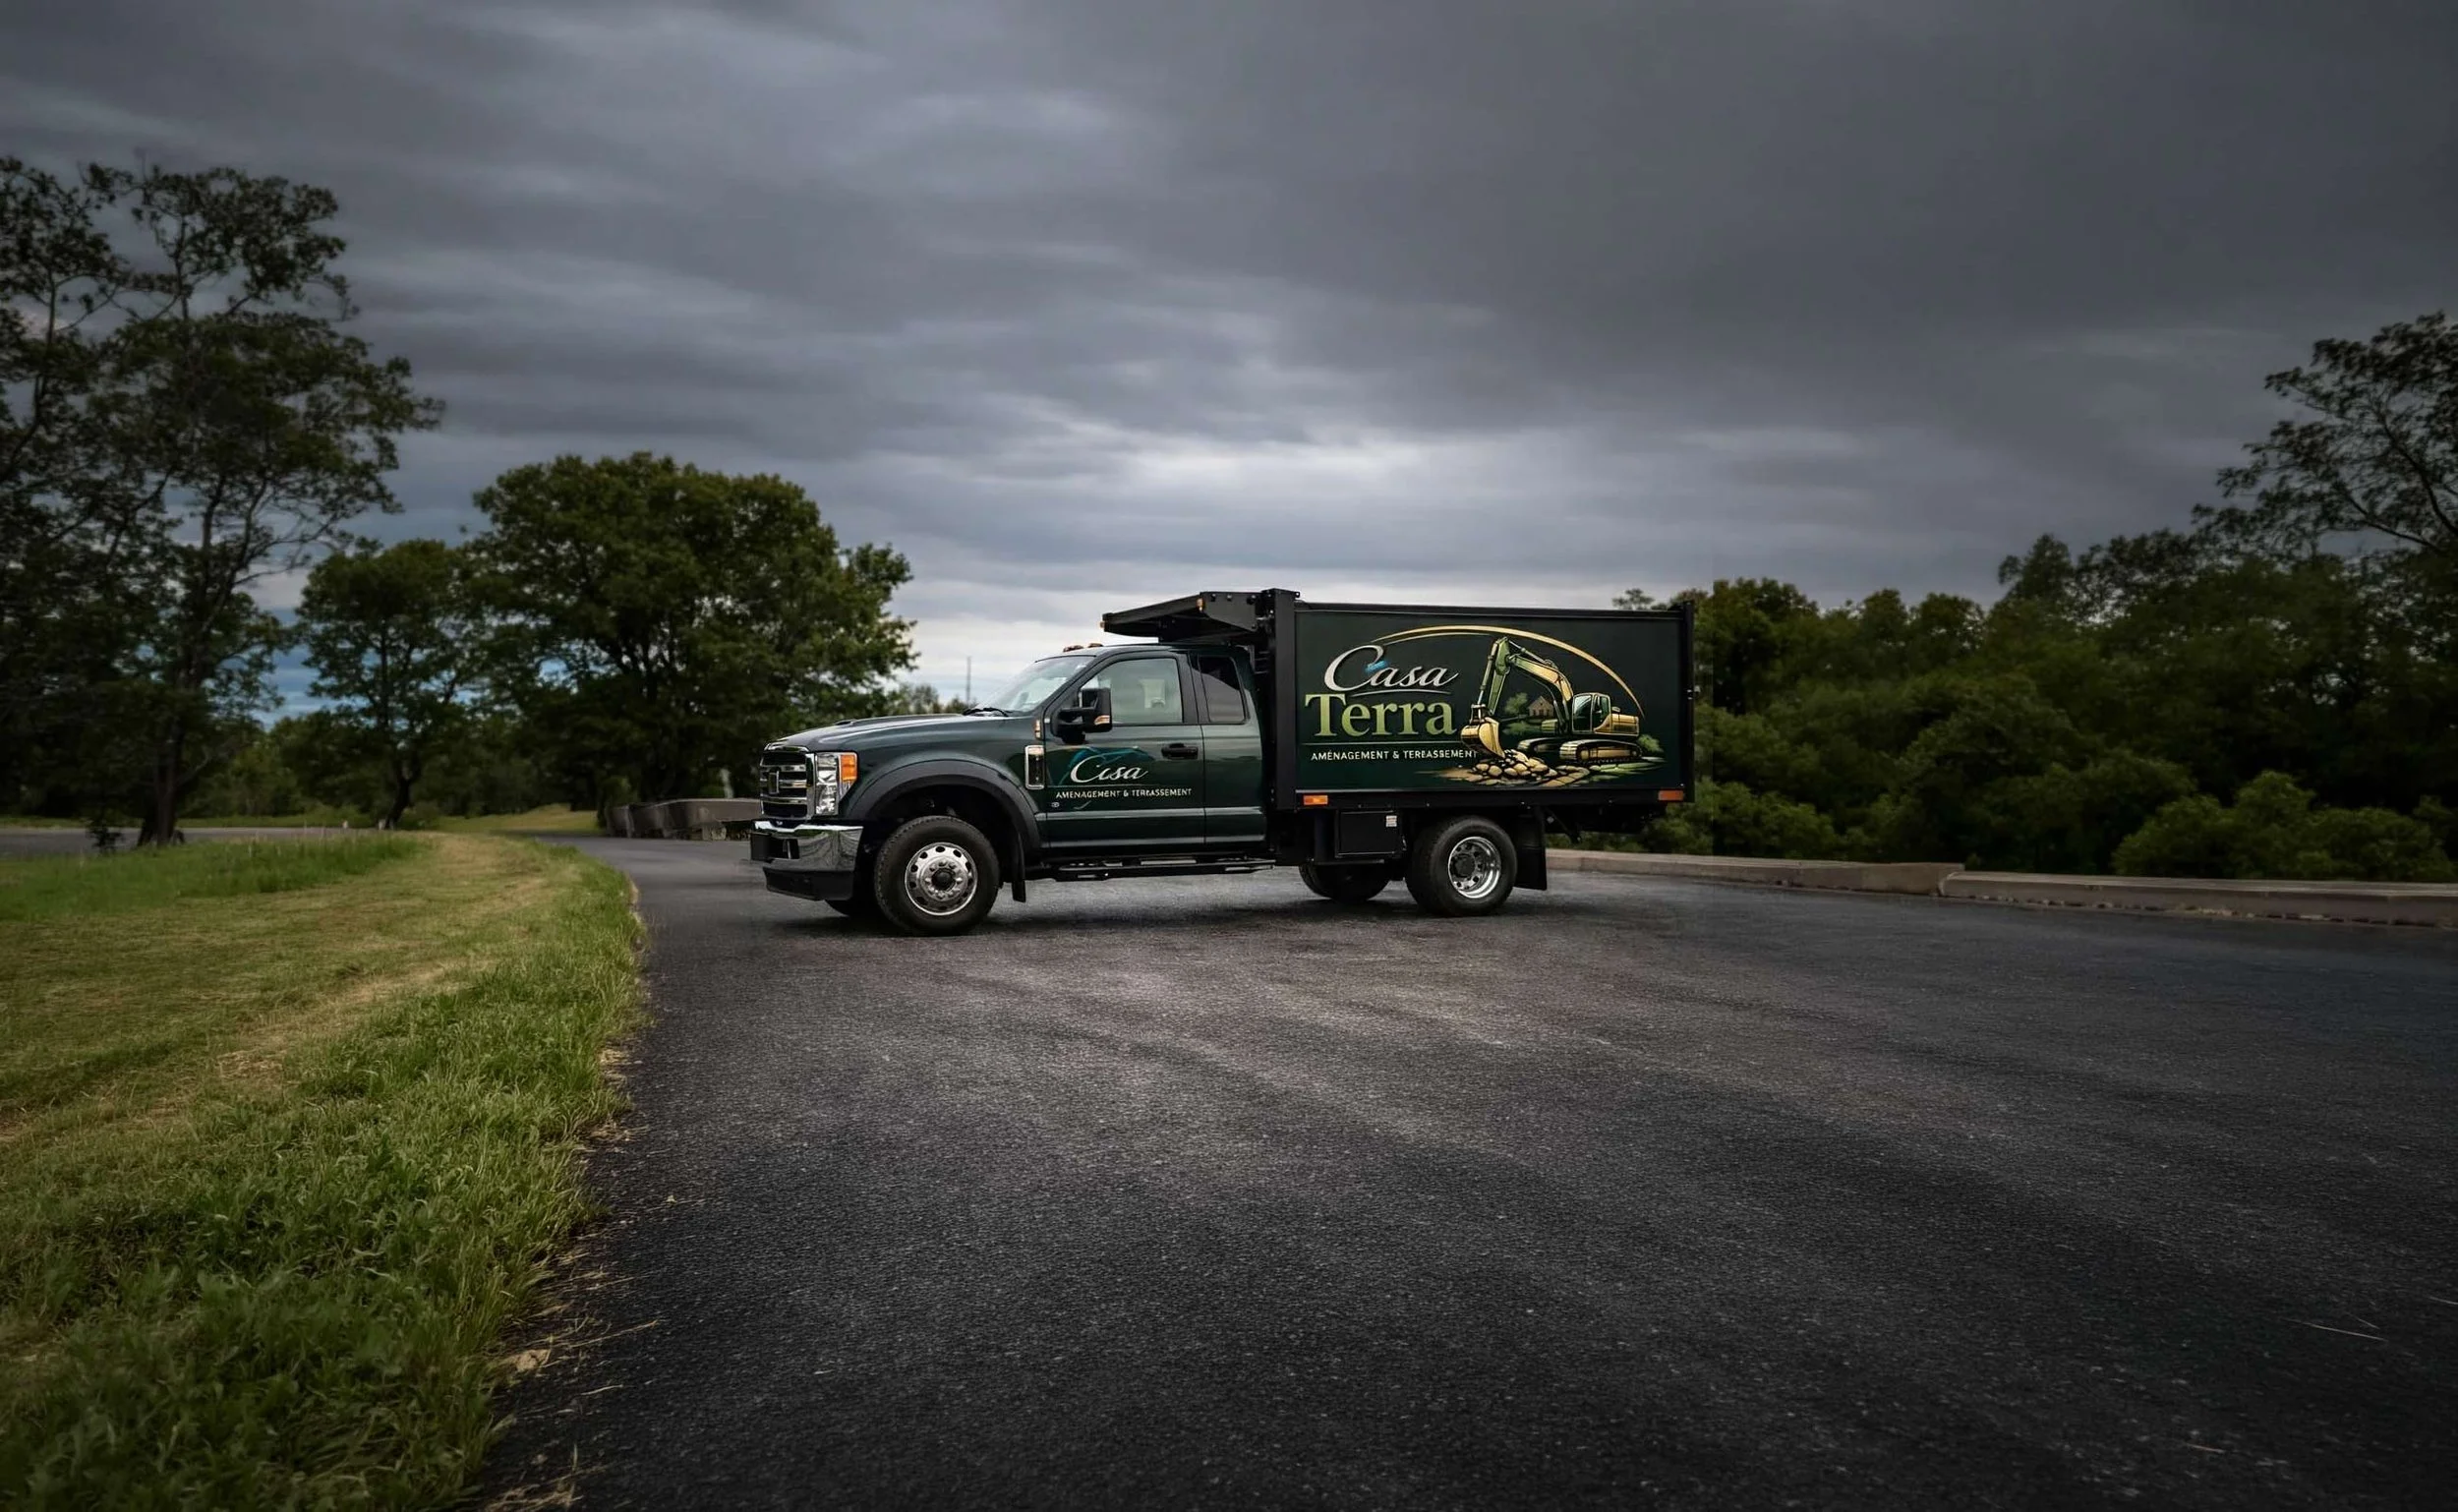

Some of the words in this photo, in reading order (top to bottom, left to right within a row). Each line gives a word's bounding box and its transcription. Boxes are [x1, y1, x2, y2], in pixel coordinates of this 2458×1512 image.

[1322, 644, 1459, 692] Casa
[1304, 693, 1457, 737] Terra
[1311, 750, 1389, 762] AMÉNAGEMENT
[1392, 750, 1400, 760] &
